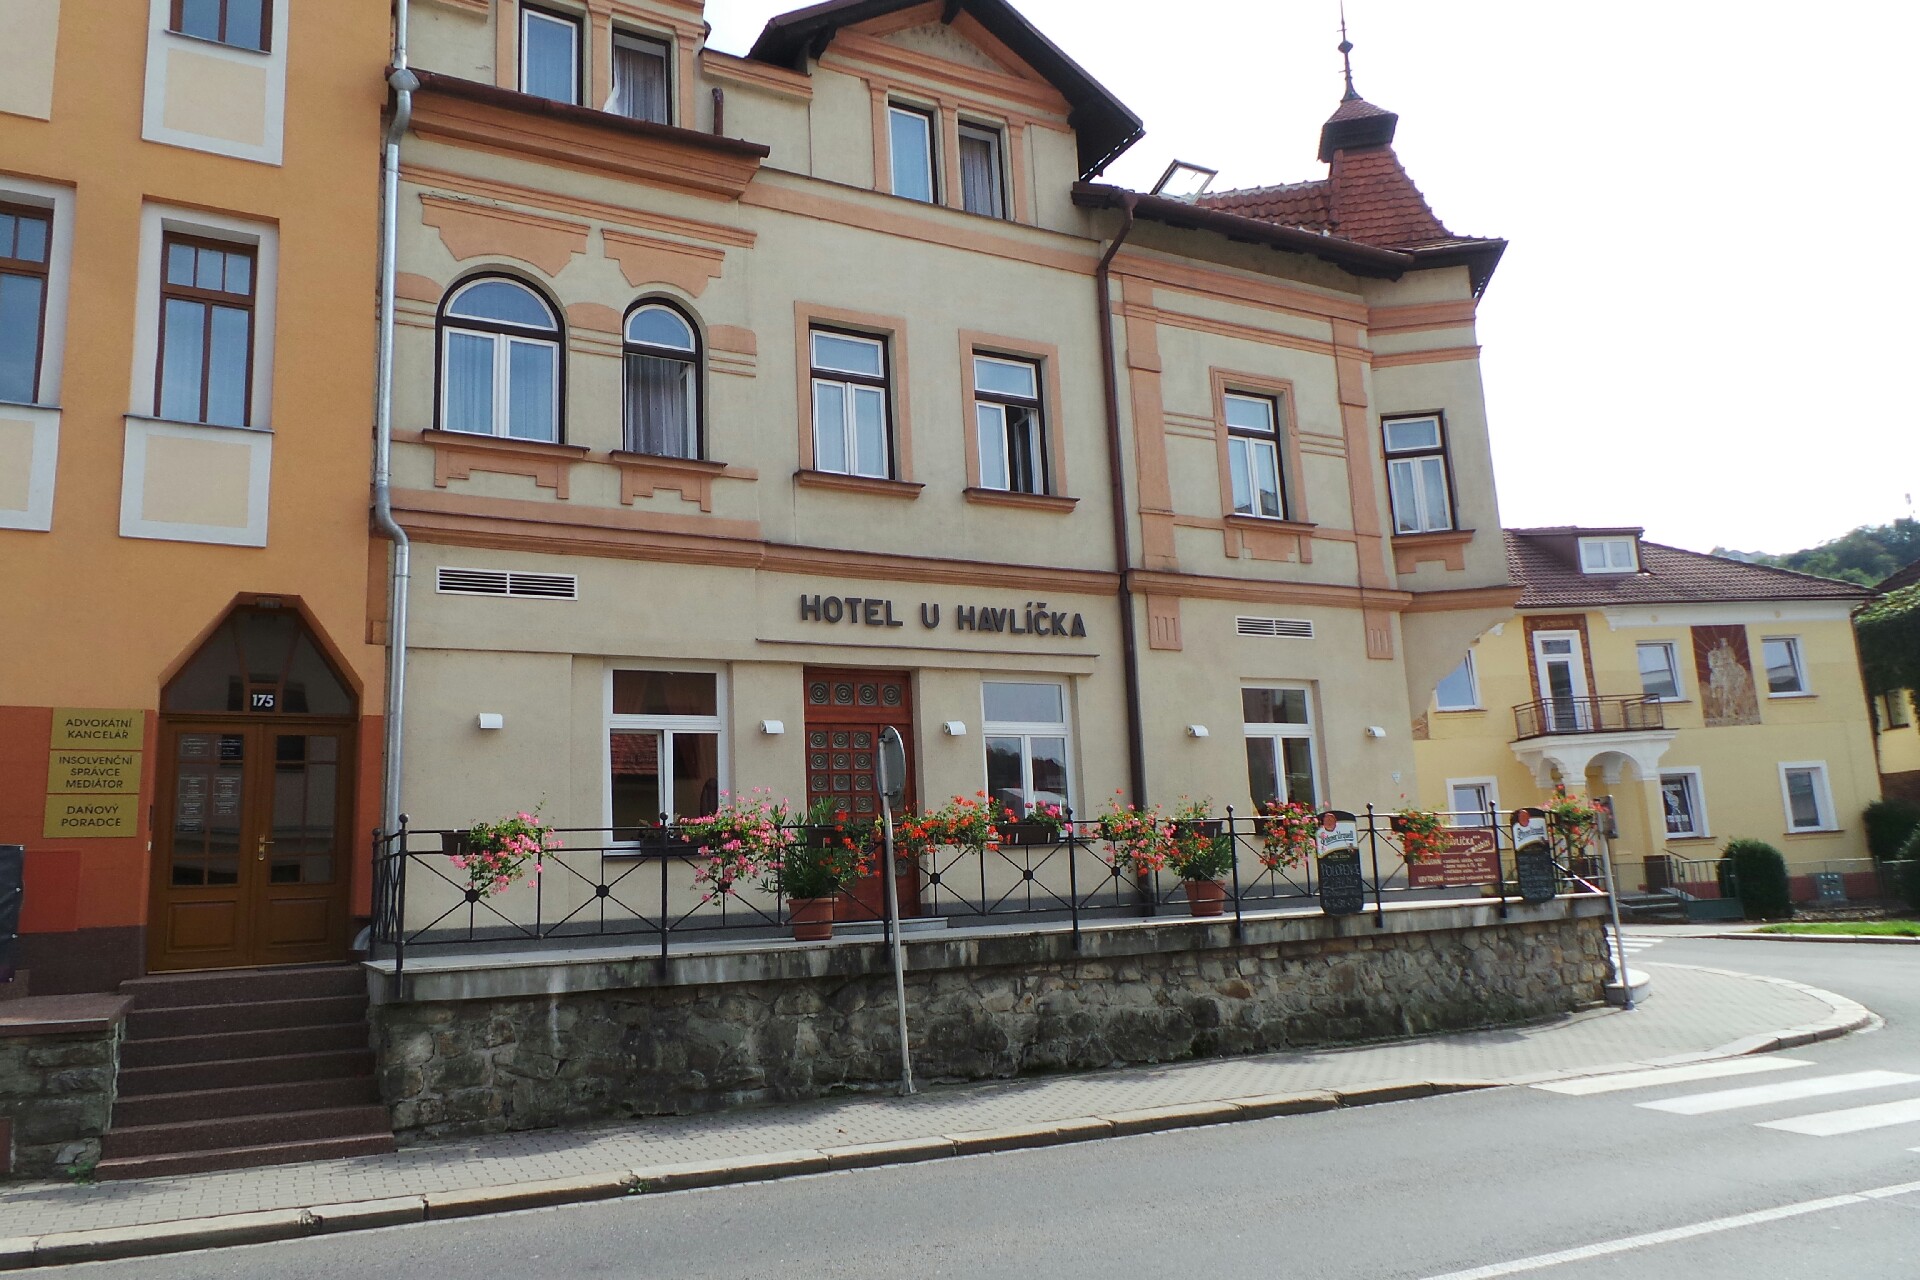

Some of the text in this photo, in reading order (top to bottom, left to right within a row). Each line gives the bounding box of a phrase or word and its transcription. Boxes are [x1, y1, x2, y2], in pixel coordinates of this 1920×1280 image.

[800, 594, 1087, 638] HOTEL U HAVLÍČKA
[252, 694, 274, 707] 175
[65, 718, 132, 728] ADVOKÁTNÍ
[67, 729, 129, 739] KANCELÁŘ
[59, 755, 133, 765] INSOLVENČNÍ
[70, 767, 120, 776] SPRÁVCE
[65, 779, 123, 788] MEDIÁTOR
[66, 803, 119, 815] DAŇOVÝ
[61, 818, 121, 827] PORADCE
